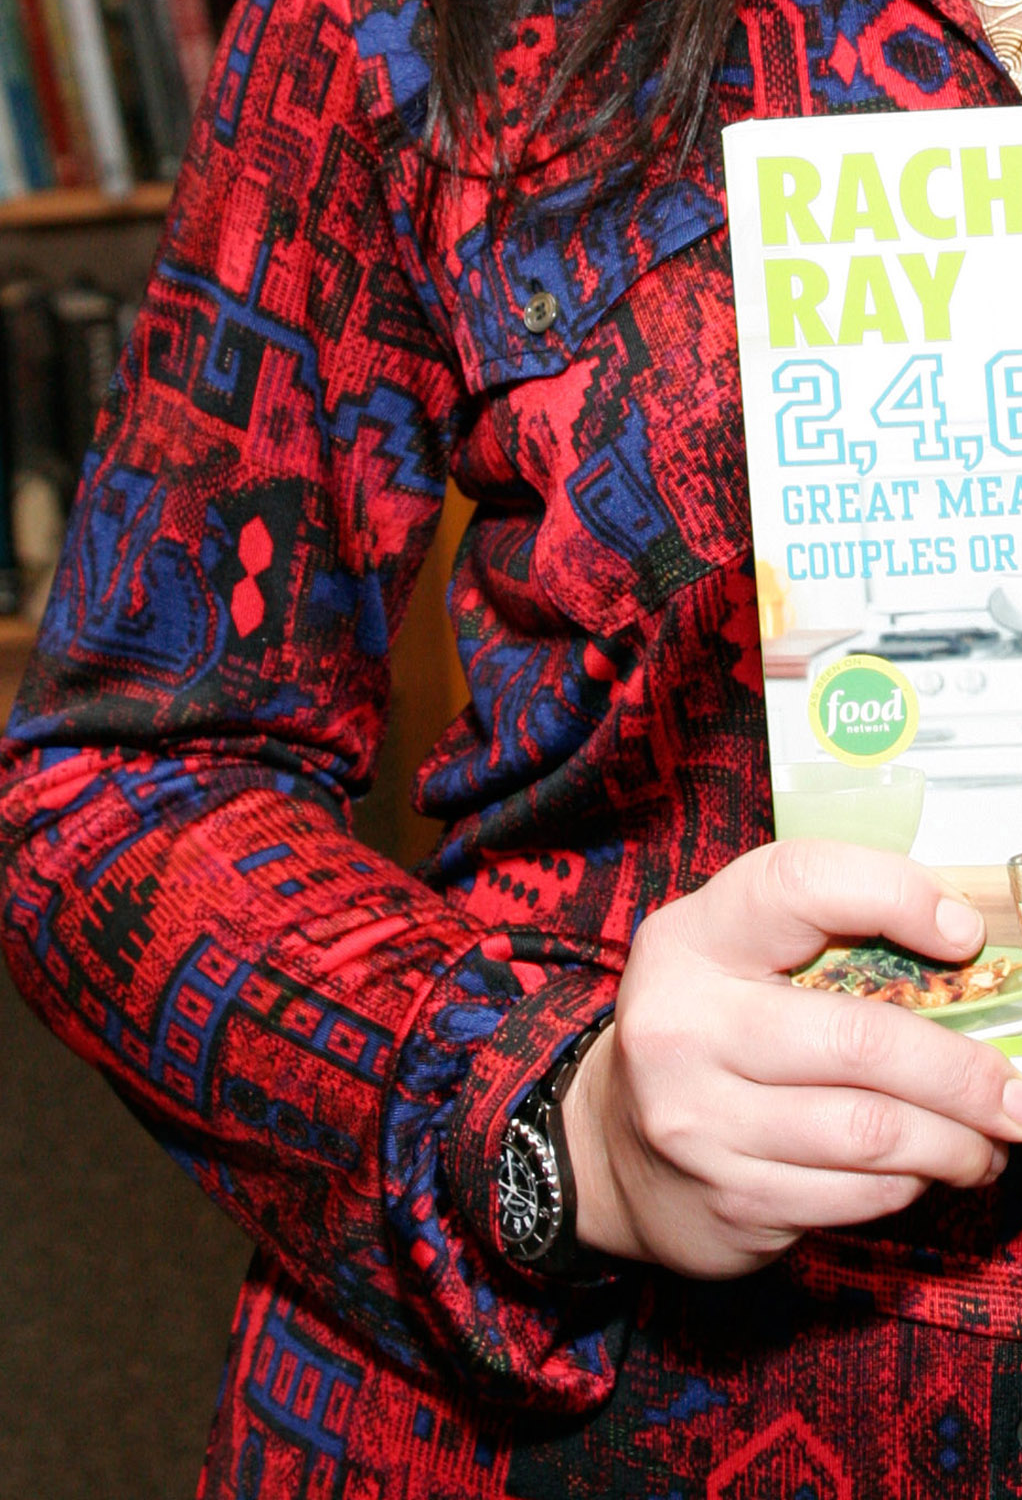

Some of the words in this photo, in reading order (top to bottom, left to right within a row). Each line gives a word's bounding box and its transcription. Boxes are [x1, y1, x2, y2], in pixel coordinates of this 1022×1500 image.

[764, 251, 965, 347] RAY
[782, 479, 920, 525] GREAT
[786, 537, 957, 580] COUPLES
[968, 533, 1018, 572] OR
[826, 688, 905, 737] food
[846, 722, 891, 734] network
